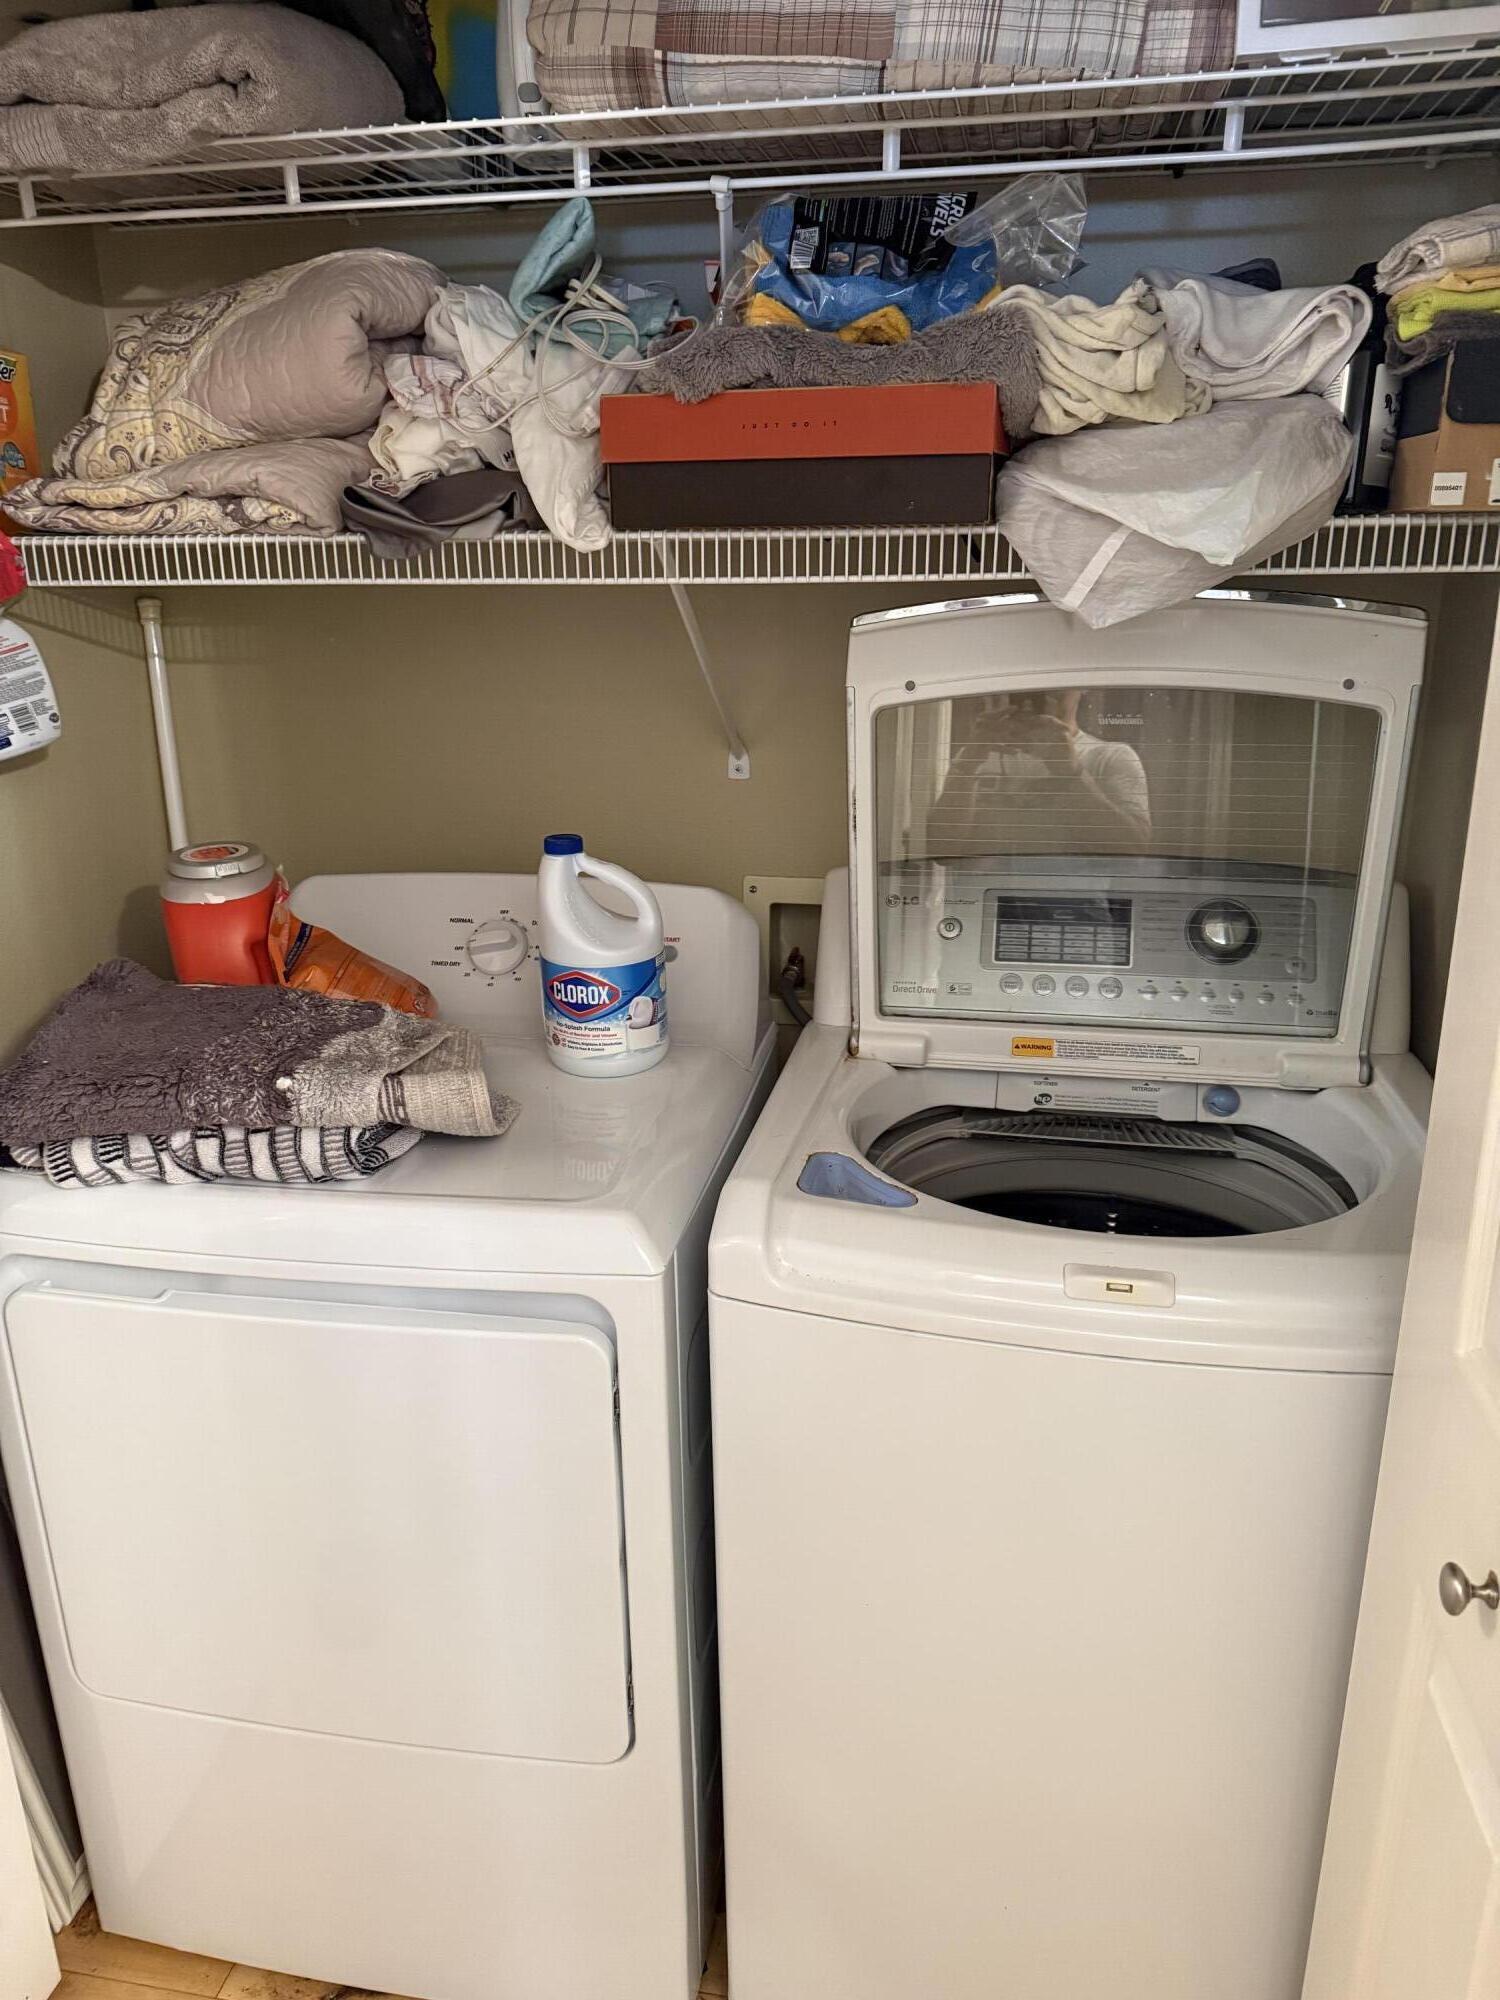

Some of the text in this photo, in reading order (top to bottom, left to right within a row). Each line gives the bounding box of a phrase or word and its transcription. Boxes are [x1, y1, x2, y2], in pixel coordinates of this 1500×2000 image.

[929, 192, 951, 237] WELS
[0, 361, 14, 380] er
[903, 896, 920, 905] LG
[553, 981, 610, 1005] CLOROX
[892, 985, 915, 993] Direct
[917, 985, 937, 994] Drive
[1020, 1043, 1053, 1051] WARNING
